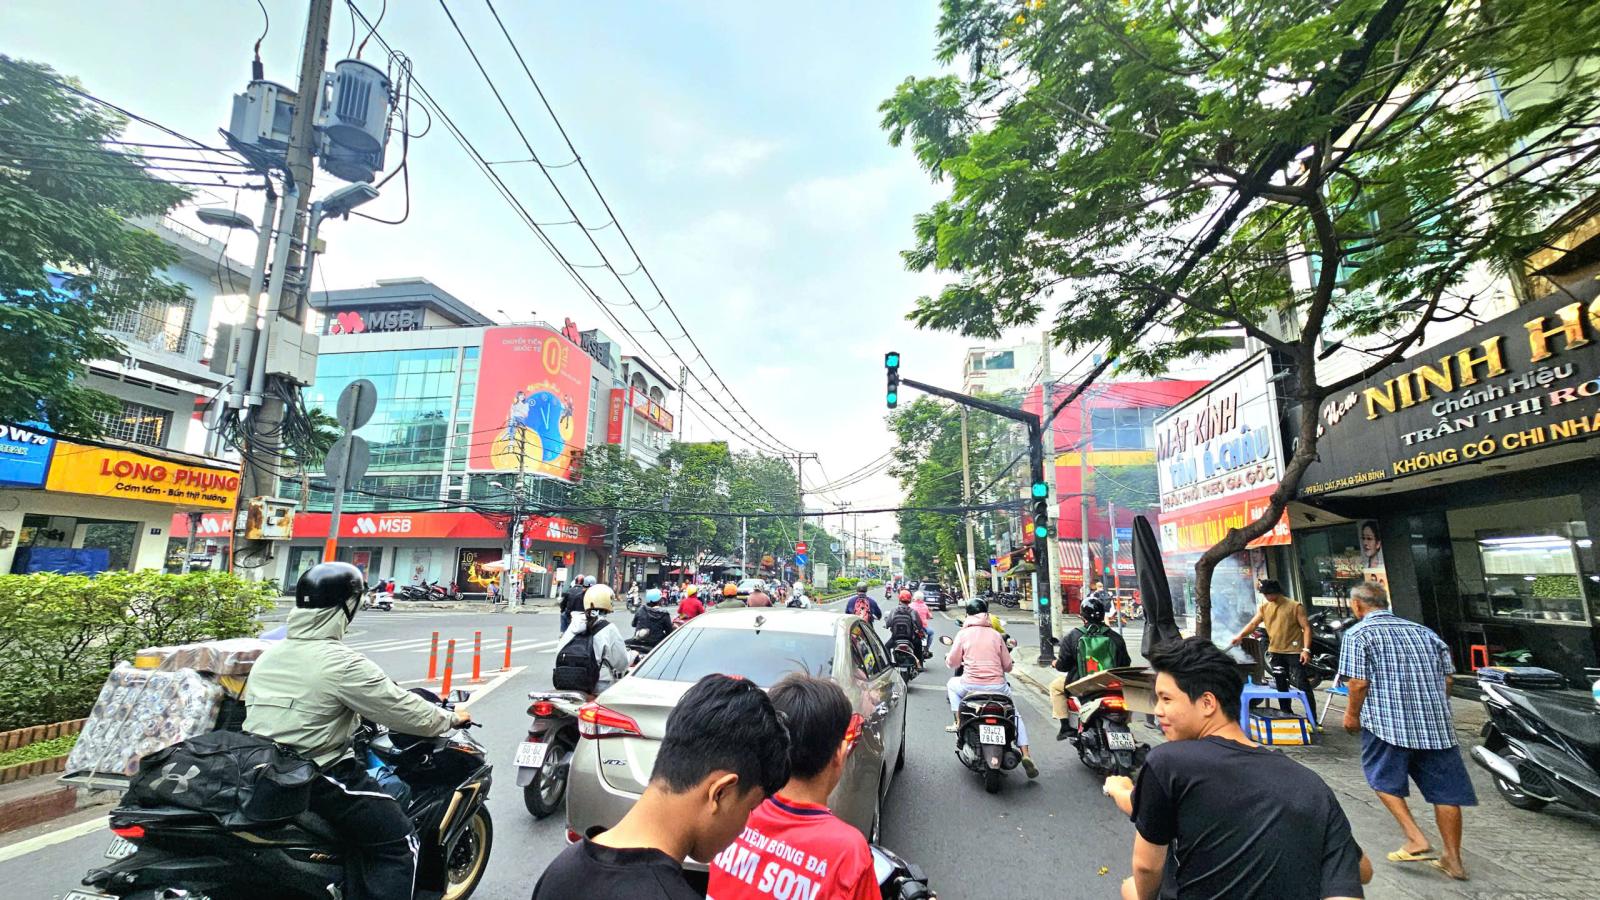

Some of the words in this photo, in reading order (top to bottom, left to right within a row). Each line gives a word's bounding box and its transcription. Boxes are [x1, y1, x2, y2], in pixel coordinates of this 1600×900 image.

[368, 310, 415, 330] MSB
[1362, 336, 1507, 420] NINH
[1431, 383, 1505, 417] Chánh
[1508, 362, 1574, 395] Hiệu
[1195, 392, 1238, 446] KÍNH
[1401, 415, 1476, 446] TRẦN
[1481, 396, 1544, 424] THỊ
[1393, 448, 1458, 475] KHÔNG
[1462, 434, 1497, 459] CÓ
[1502, 426, 1546, 450] CHI
[100, 458, 167, 482] LONG
[173, 469, 239, 493] PHỤNG
[378, 518, 412, 533] MSB
[758, 861, 821, 900] SƠN
[768, 839, 804, 867] BÓNG
[805, 853, 828, 878] ĐÁ
